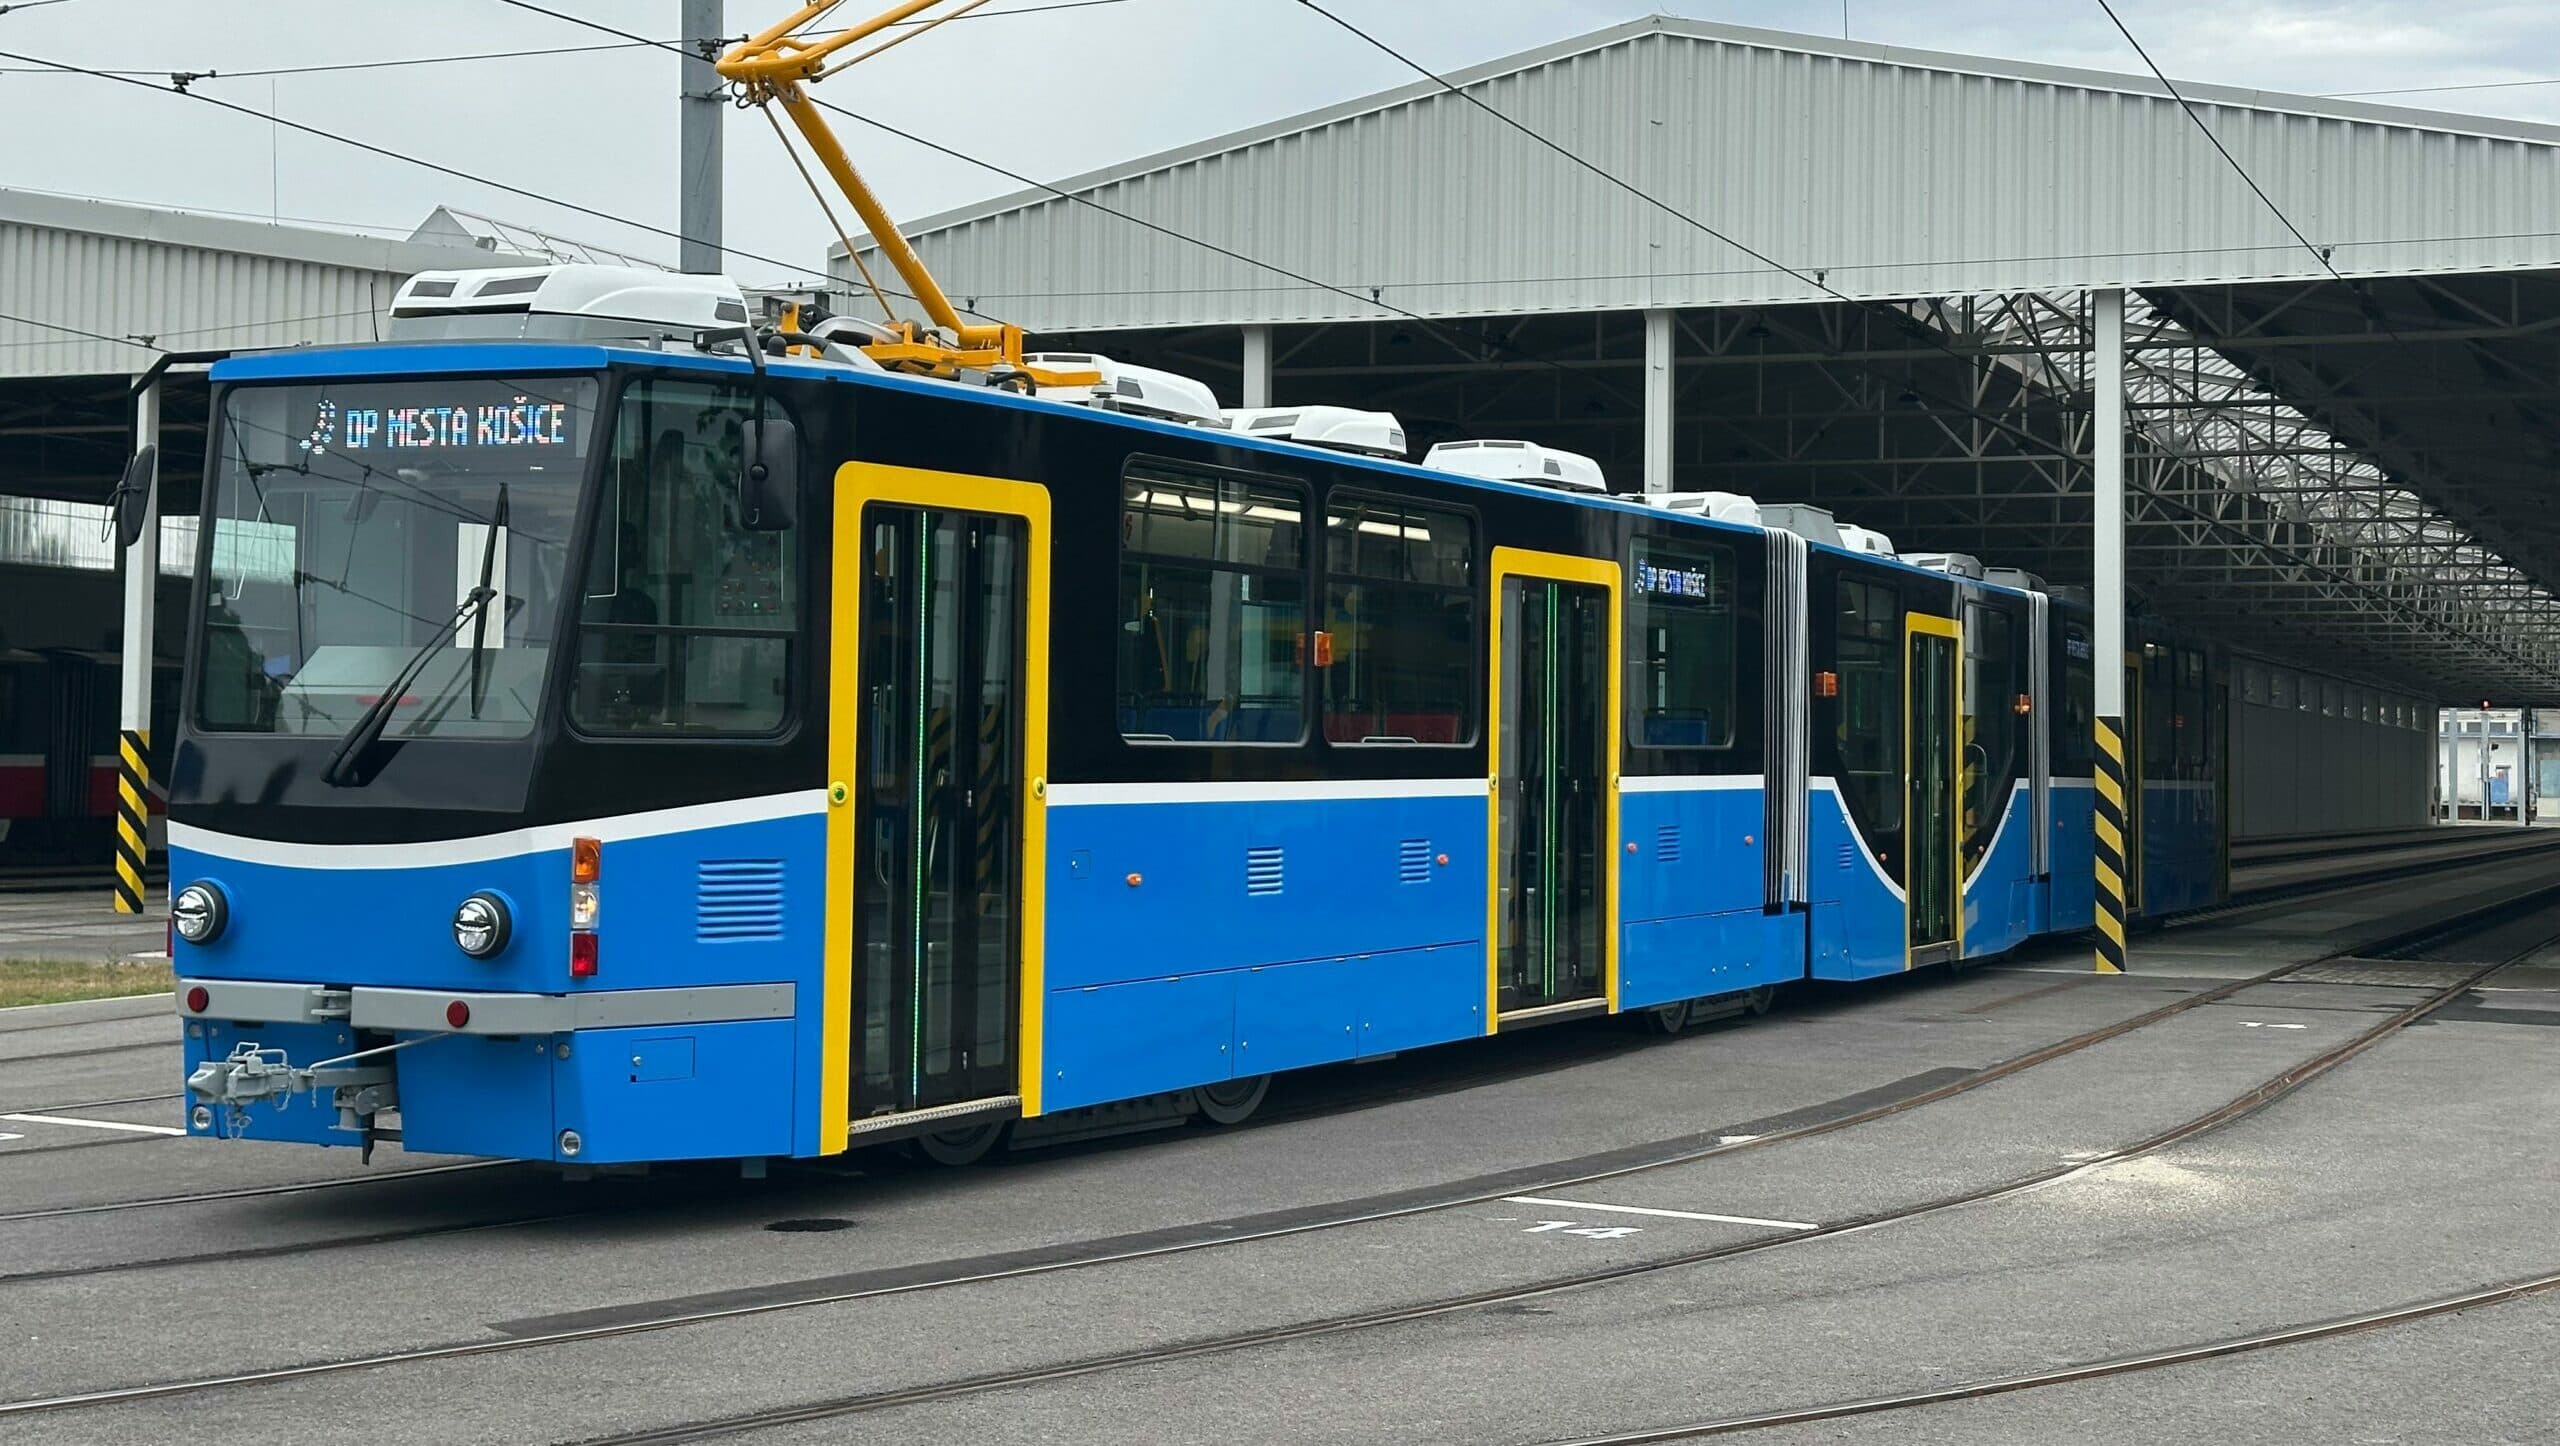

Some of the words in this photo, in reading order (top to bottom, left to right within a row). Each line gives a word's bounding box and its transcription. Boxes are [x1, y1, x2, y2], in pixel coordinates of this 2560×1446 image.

[346, 409, 378, 449] DP
[387, 406, 468, 448] MESTA
[477, 396, 565, 446] KOŠICE
[1521, 1220, 1644, 1239] 14
